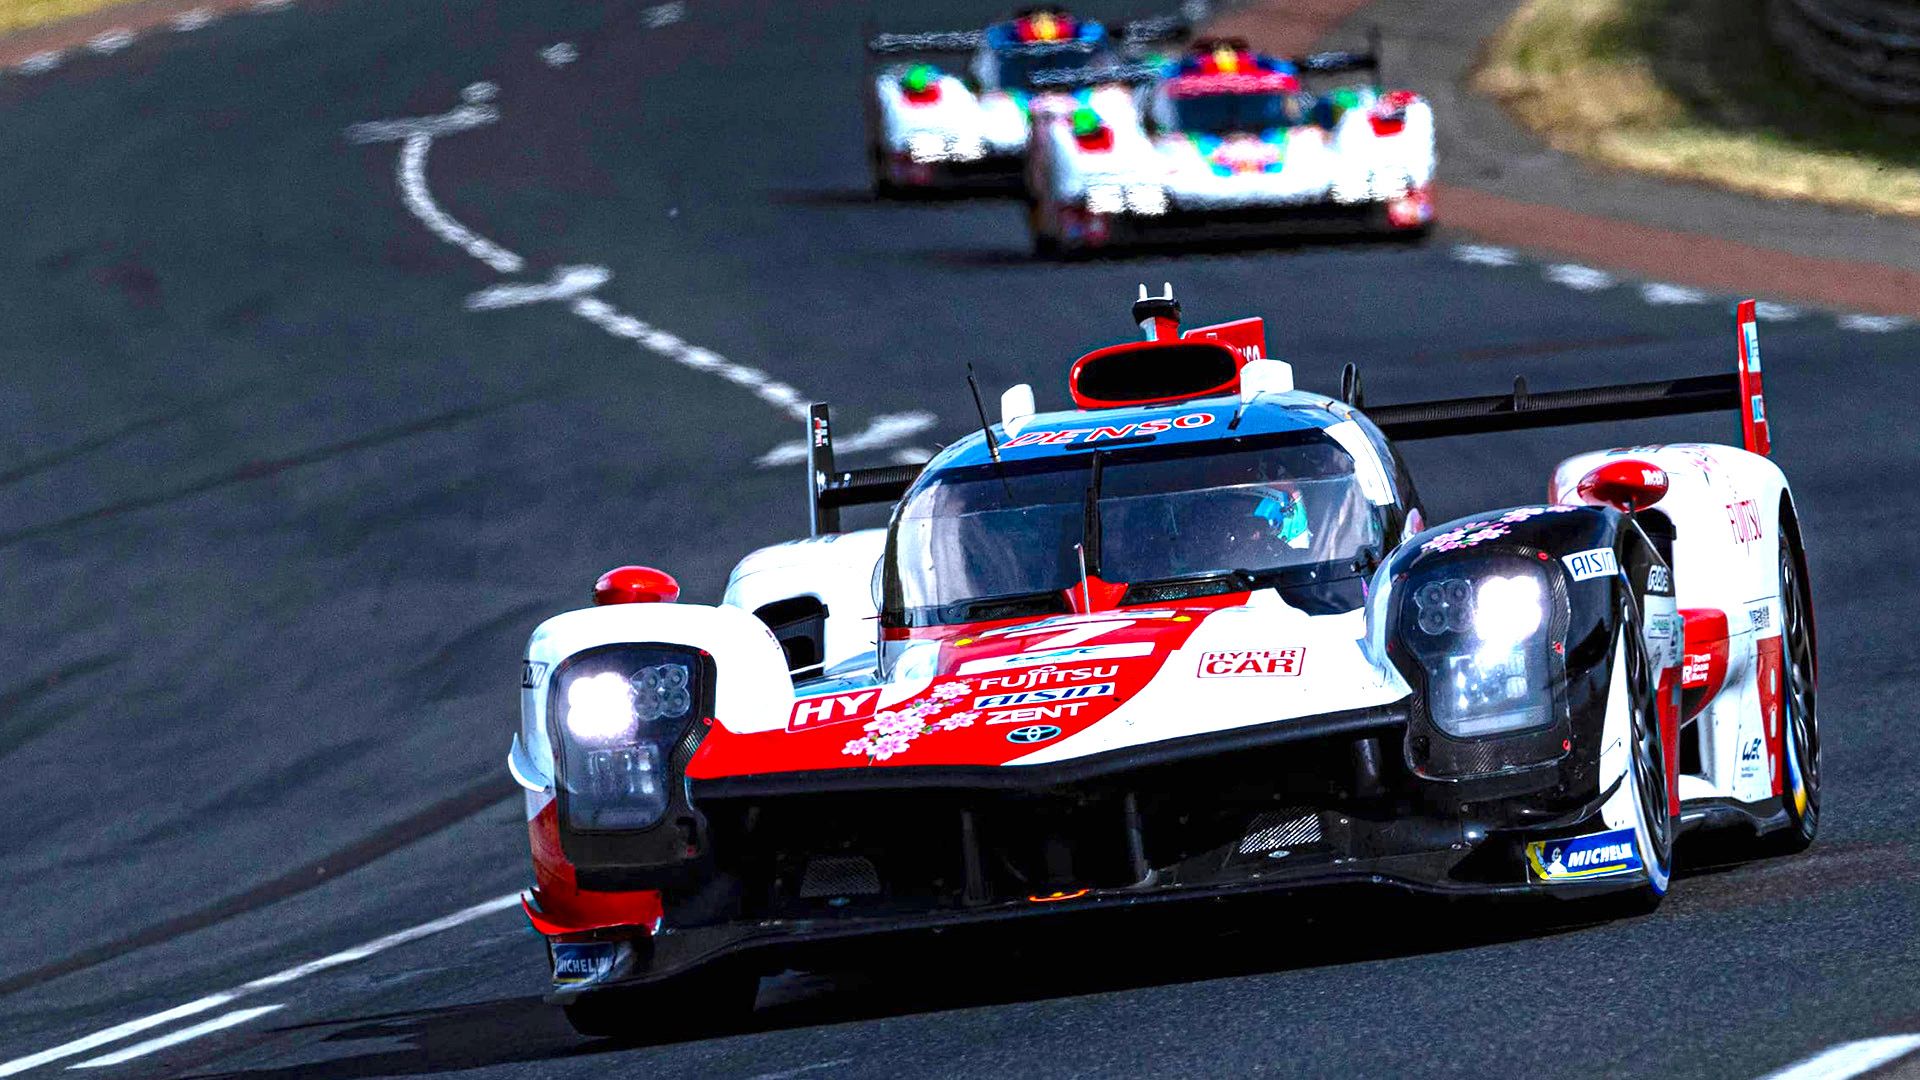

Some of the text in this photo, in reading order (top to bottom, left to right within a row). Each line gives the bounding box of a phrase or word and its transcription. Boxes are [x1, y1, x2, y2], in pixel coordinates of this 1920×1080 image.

[1002, 413, 1216, 449] DENSO
[1571, 551, 1617, 576] AISIN
[1206, 649, 1297, 660] HYPER
[979, 665, 1120, 690] FUJITSU
[1206, 659, 1294, 675] CAR
[977, 684, 1111, 708] AISIN
[793, 693, 872, 727] HY
[986, 702, 1089, 725] ZENT
[1567, 843, 1634, 867] MICHELIN
